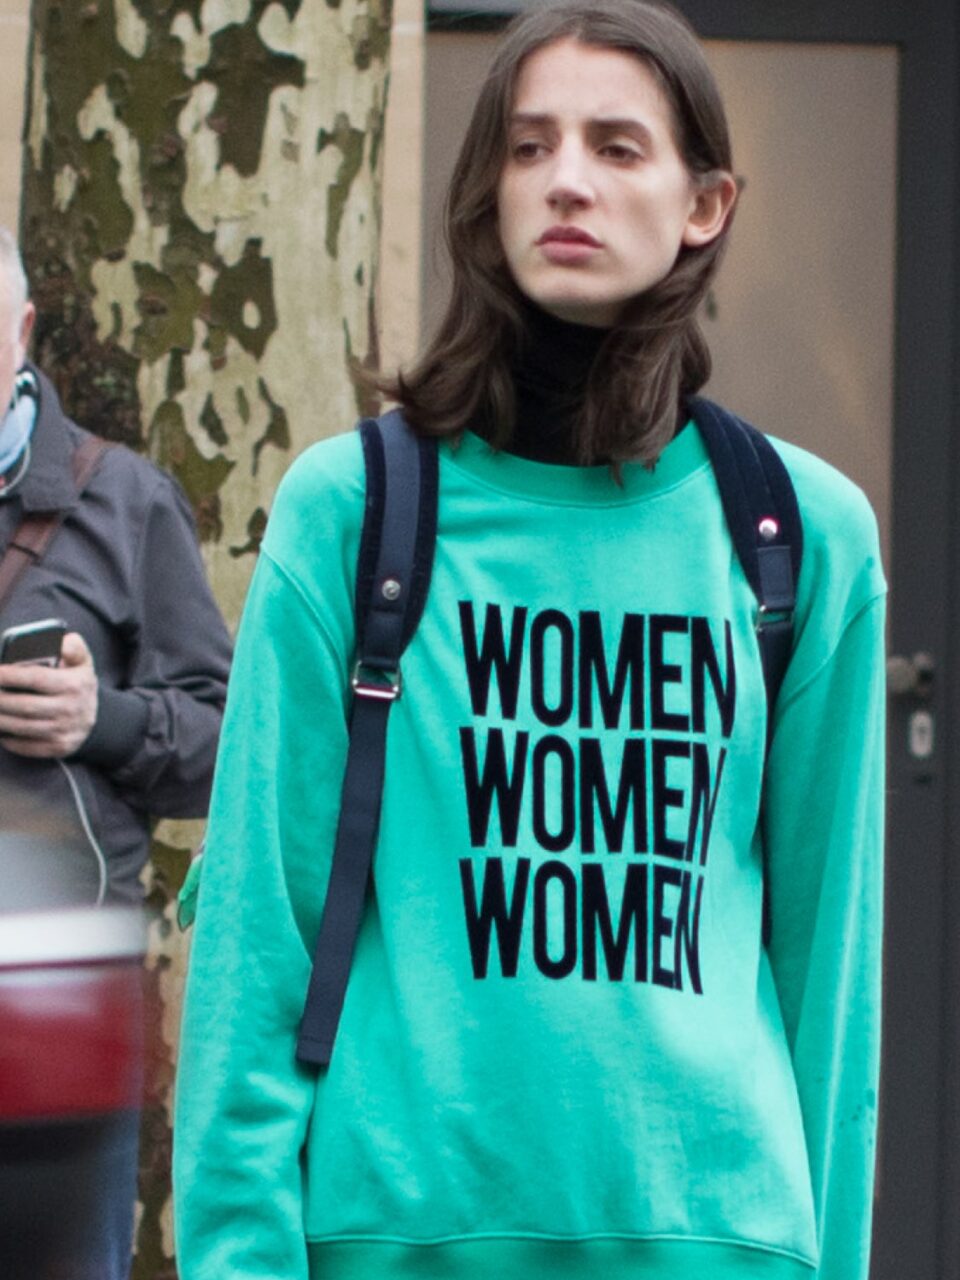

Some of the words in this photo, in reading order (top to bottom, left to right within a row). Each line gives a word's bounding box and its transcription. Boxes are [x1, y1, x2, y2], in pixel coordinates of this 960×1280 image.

[458, 600, 736, 738] WOMEN
[459, 726, 727, 867] WOMEN
[459, 857, 704, 995] WOMEN
